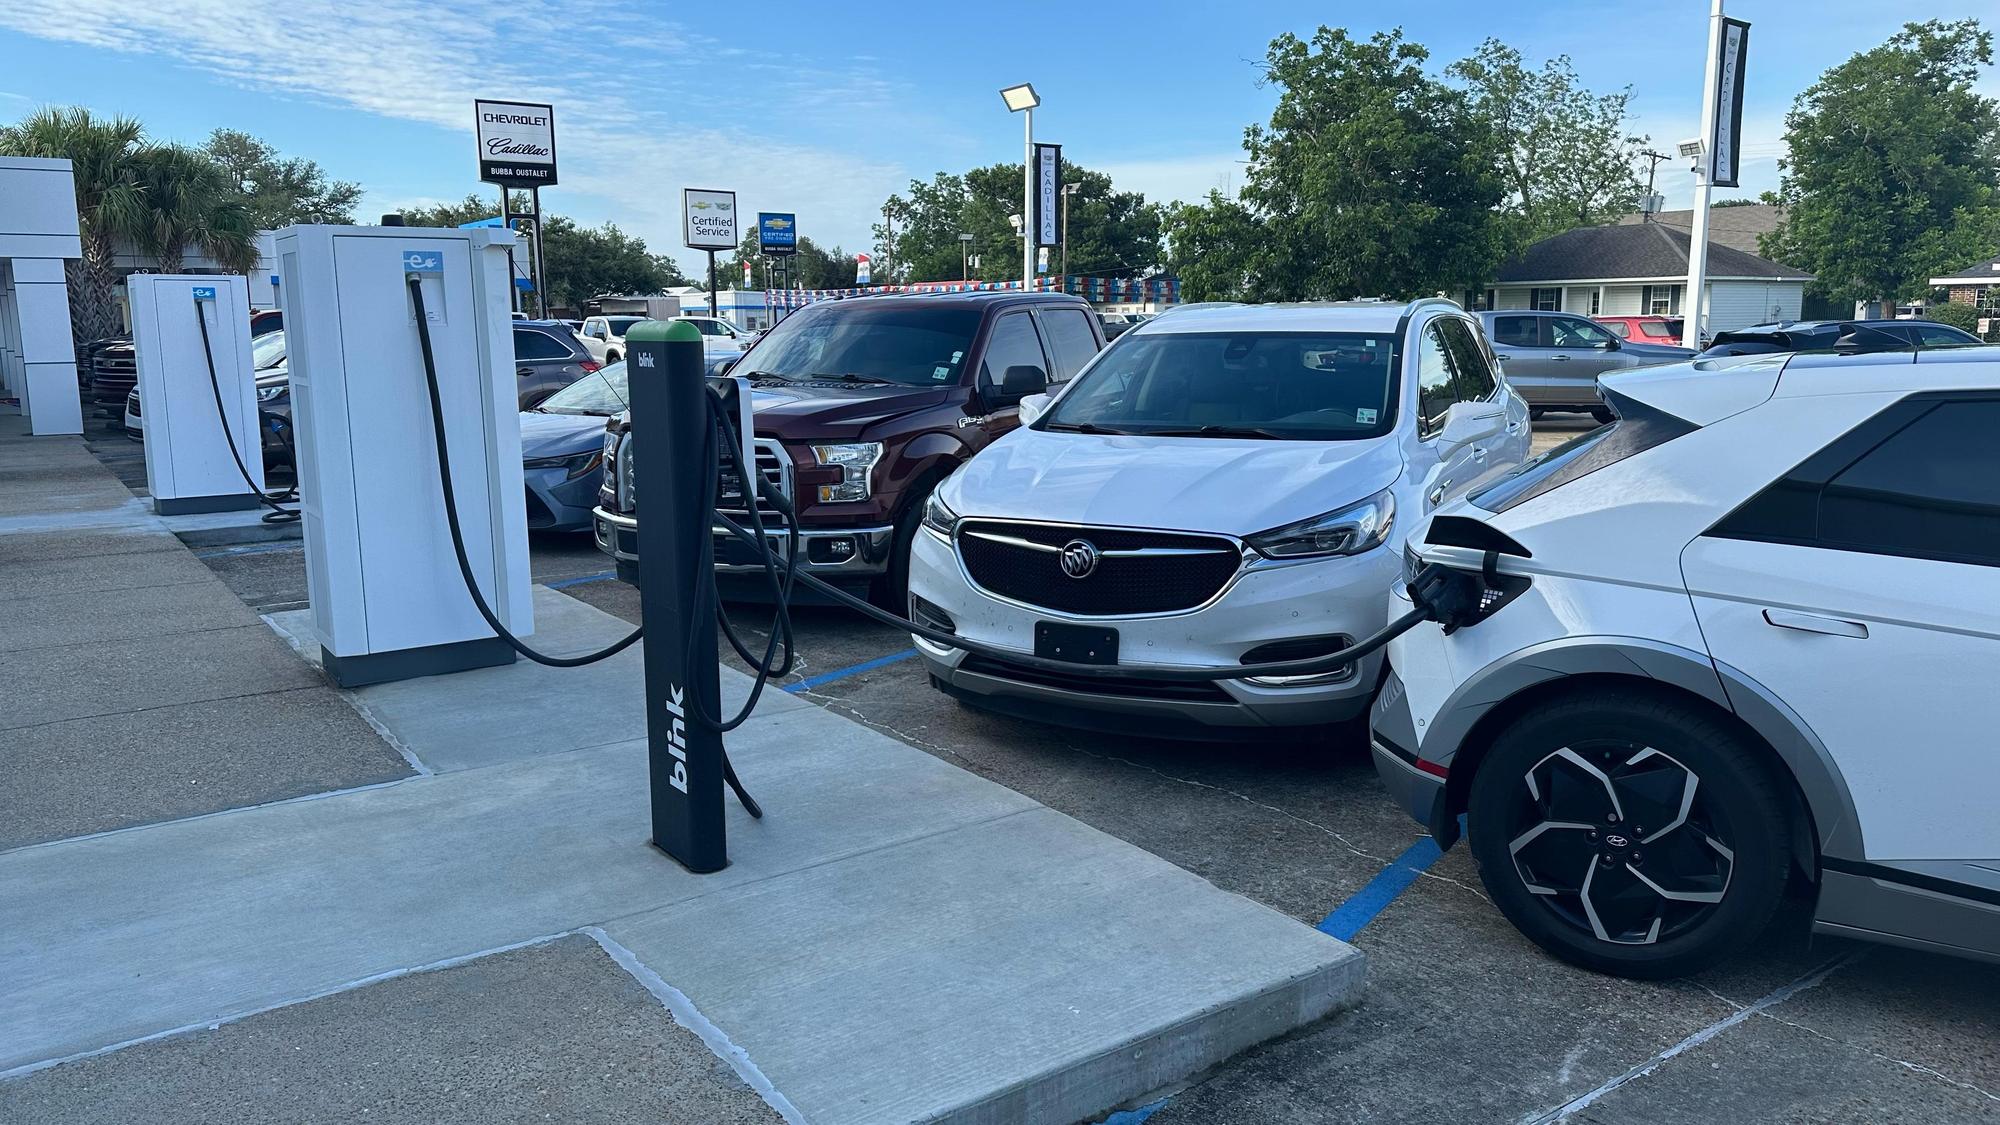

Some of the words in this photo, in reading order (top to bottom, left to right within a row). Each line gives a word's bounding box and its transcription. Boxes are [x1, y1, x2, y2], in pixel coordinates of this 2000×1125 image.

[483, 113, 548, 127] CHEVROLET
[486, 137, 549, 156] Cadillac
[490, 167, 513, 176] BUBBA
[515, 168, 548, 177] OUSTALET
[1044, 169, 1052, 238] CADILLAC
[691, 215, 733, 227] Certified
[695, 226, 730, 237] Service
[638, 352, 655, 368] blink
[666, 682, 688, 794] blink
